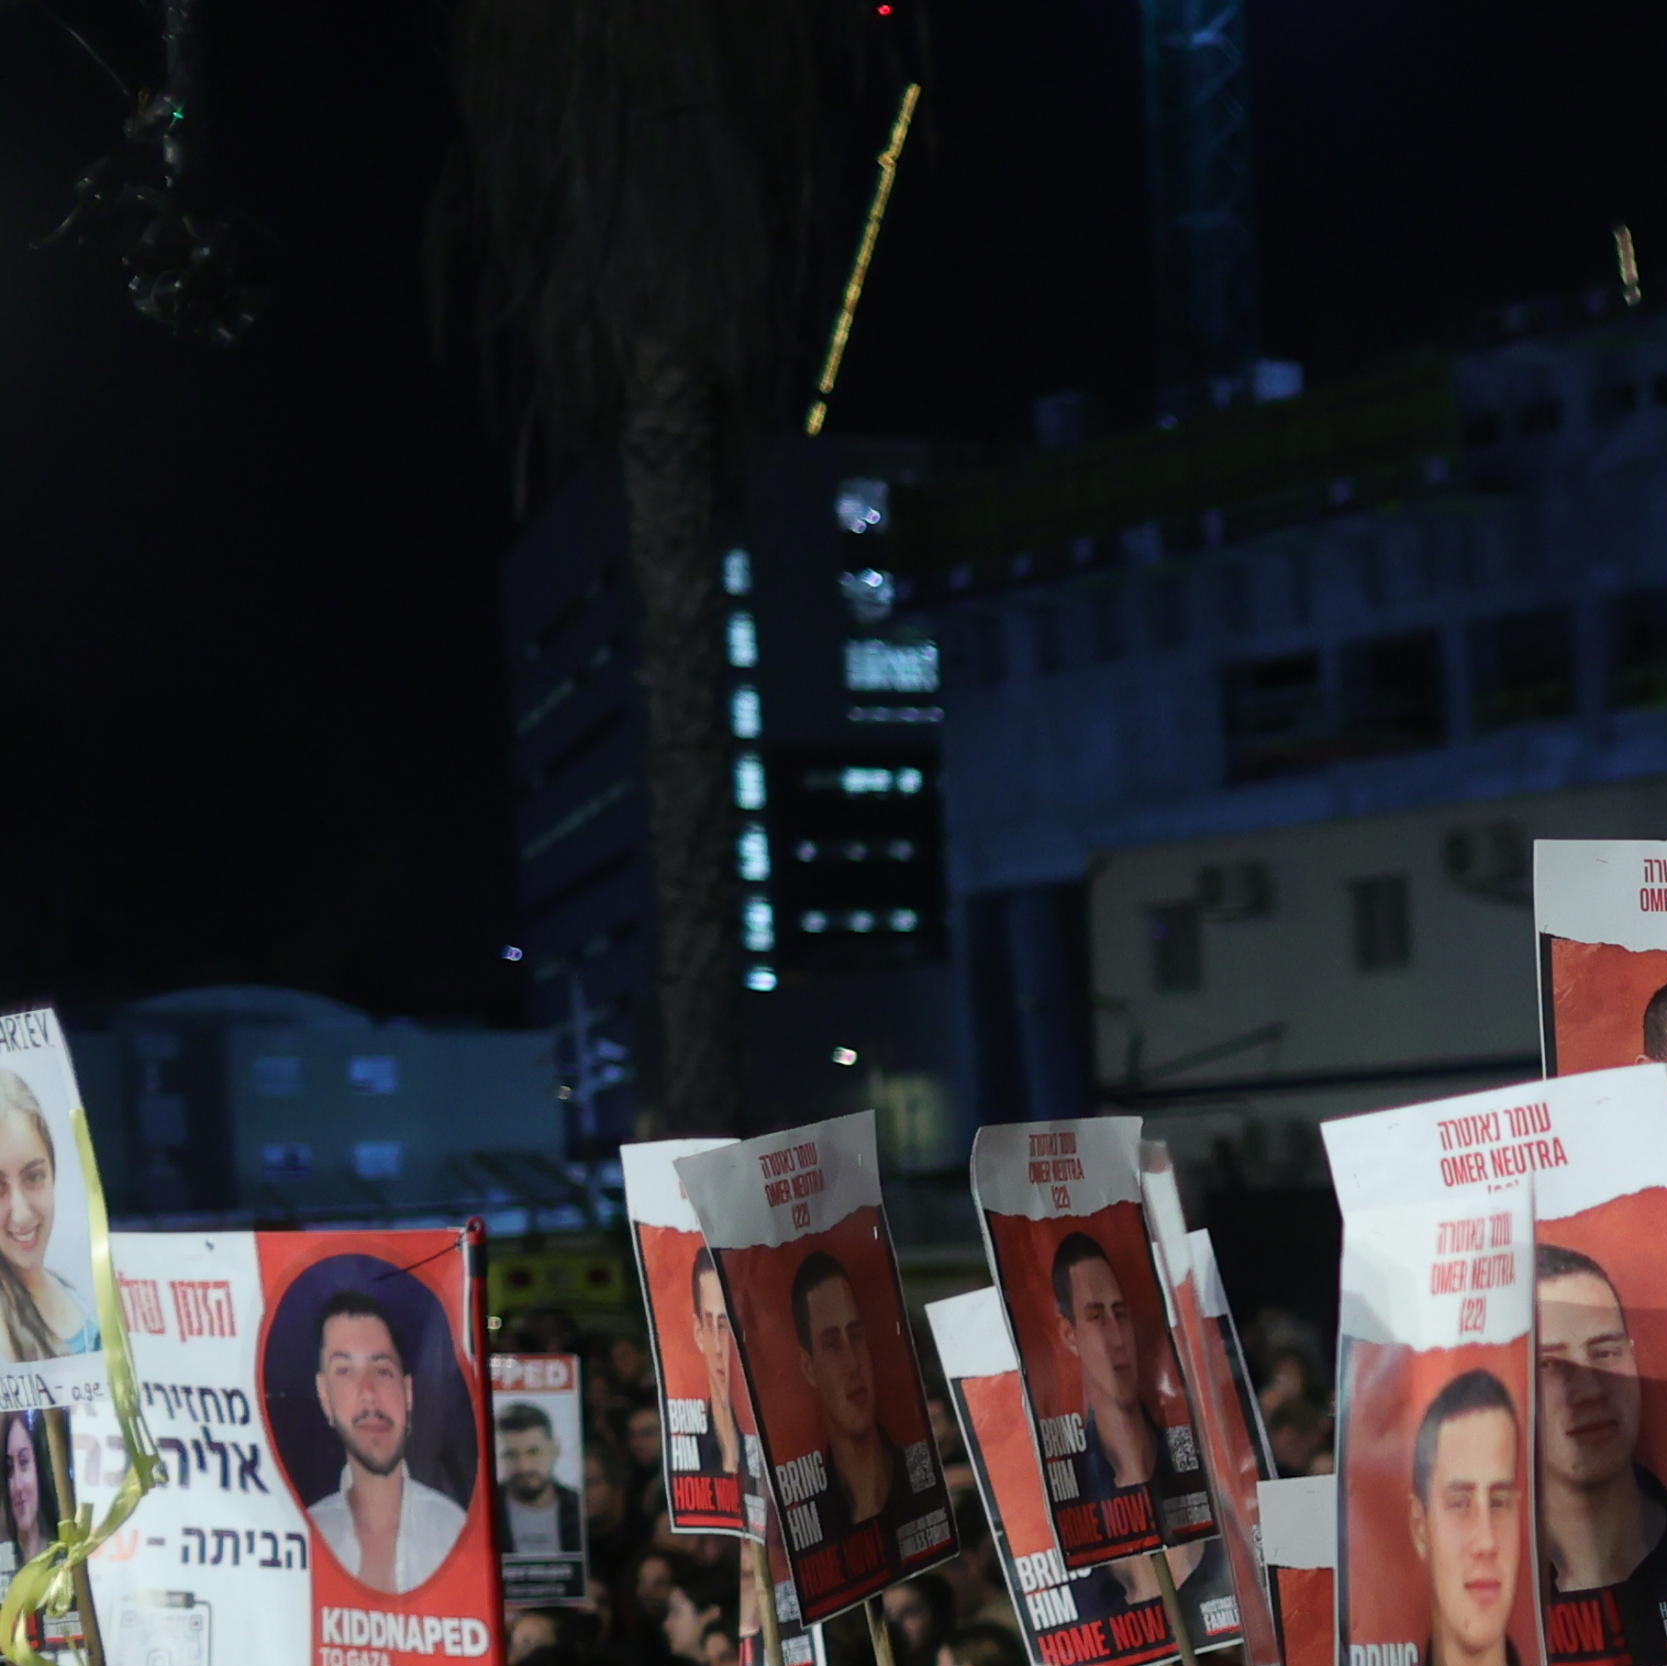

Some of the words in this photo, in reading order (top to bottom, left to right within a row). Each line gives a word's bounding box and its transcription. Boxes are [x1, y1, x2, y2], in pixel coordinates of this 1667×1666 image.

[1437, 1109, 1502, 1152] נאוטרה
[1504, 1102, 1552, 1141] עומר
[1439, 1152, 1490, 1187] OMER
[1492, 1137, 1569, 1179] NEUTRA
[1052, 1186, 1071, 1209] (22)
[1430, 1259, 1467, 1296] OMER
[1459, 1297, 1486, 1334] (22)
[72, 1382, 104, 1401] age
[143, 1382, 250, 1425] מחזירי
[667, 1399, 708, 1434] BRING
[1040, 1412, 1086, 1459] BRING
[671, 1435, 701, 1471] HIM
[672, 1476, 714, 1512] HOME
[775, 1450, 828, 1506] BRING
[1048, 1459, 1079, 1502] HIM
[786, 1501, 823, 1551] HIM
[1059, 1505, 1102, 1549] HOME
[1104, 1484, 1156, 1540] NOW!
[182, 1527, 307, 1569] הביתה
[321, 1607, 489, 1657] KIDDNAPED
[1026, 1589, 1078, 1632] HIM
